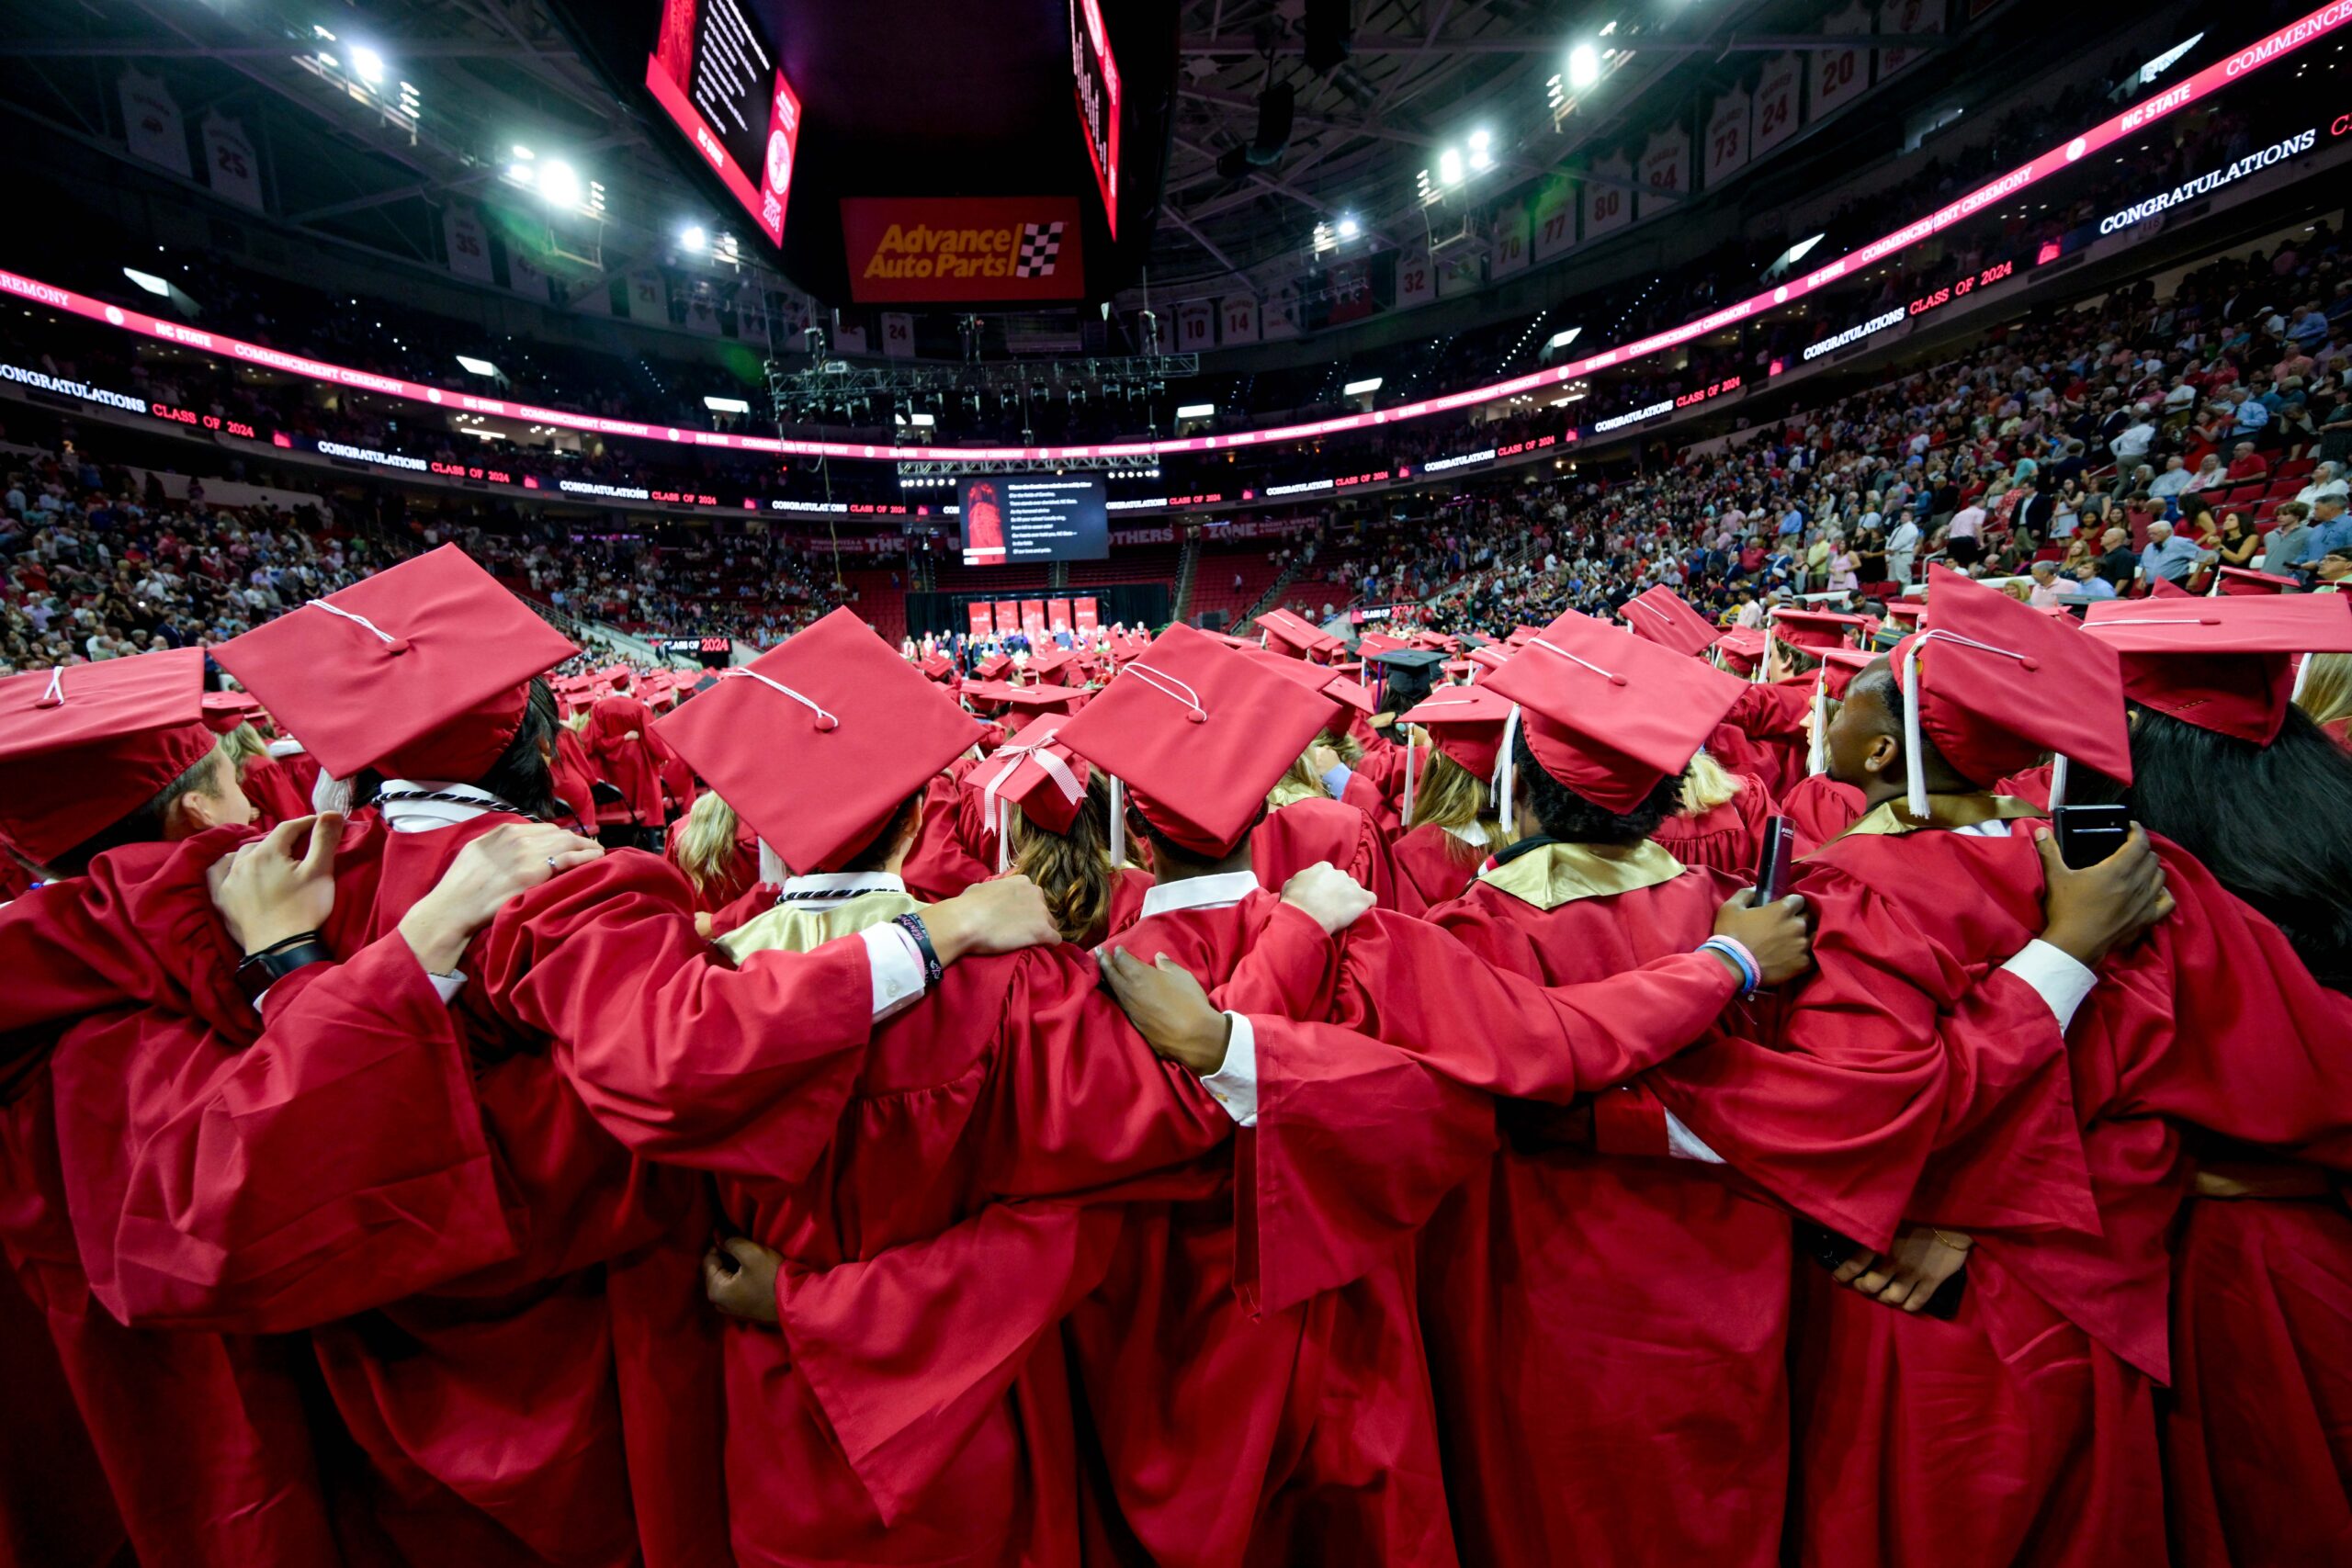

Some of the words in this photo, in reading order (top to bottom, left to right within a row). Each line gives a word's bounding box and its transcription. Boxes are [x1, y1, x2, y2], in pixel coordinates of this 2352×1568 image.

[1762, 94, 1787, 135] 24
[2122, 109, 2143, 130] NC
[2145, 84, 2190, 118] STATE
[217, 145, 248, 179] 25
[1715, 128, 1737, 167] 73
[2098, 127, 2315, 234] CONGRATULATIONS
[1595, 191, 1619, 220] 80
[1862, 205, 1960, 261] COMMENCEMENT
[1962, 167, 2031, 212] CEREMONY
[876, 224, 1011, 254] Advance
[1545, 215, 1566, 244] 77
[1500, 236, 1520, 264] 70
[864, 253, 933, 279] Auto
[934, 254, 1007, 277] Parts
[1405, 270, 1424, 293] 32
[1910, 288, 1950, 315] CLASS
[1955, 276, 1974, 295] OF
[1981, 261, 2012, 286] 2024
[155, 322, 175, 337] NC
[176, 328, 211, 346] STATE
[889, 324, 907, 340] 24
[1188, 320, 1204, 339] 10
[1231, 312, 1248, 333] 14
[1804, 307, 1905, 360] CONGRATULATIONS
[235, 344, 338, 378] COMMENCEMENT
[341, 371, 402, 392] CEREMONY
[0, 365, 146, 412] ONGRATULATIONS
[1677, 390, 1704, 407] CLASS
[1707, 384, 1719, 397] OF
[1722, 377, 1740, 391] 2024
[153, 404, 197, 424] CLASS
[203, 416, 220, 429] OF
[227, 421, 254, 437] 2024
[1595, 400, 1673, 432] CONGRATULATIONS
[318, 441, 426, 470] CONGRATULATIONS
[1498, 444, 1522, 456] CLASS
[1525, 440, 1536, 450] OF
[1539, 435, 1555, 447] 2024
[431, 462, 465, 476] CLASS
[469, 468, 483, 479] OF
[488, 471, 510, 483] 2024
[1425, 450, 1495, 471] CONGRATULATIONS
[560, 480, 649, 499] CONGRATULATIONS
[1266, 479, 1333, 495] CONGRATULATIONS
[1335, 476, 1358, 486] CLASS
[1361, 474, 1371, 482] OF
[651, 491, 680, 502] CLASS
[683, 494, 695, 502] OF
[698, 495, 717, 505] 2024
[865, 537, 905, 552] THE
[701, 637, 729, 652] 2024
